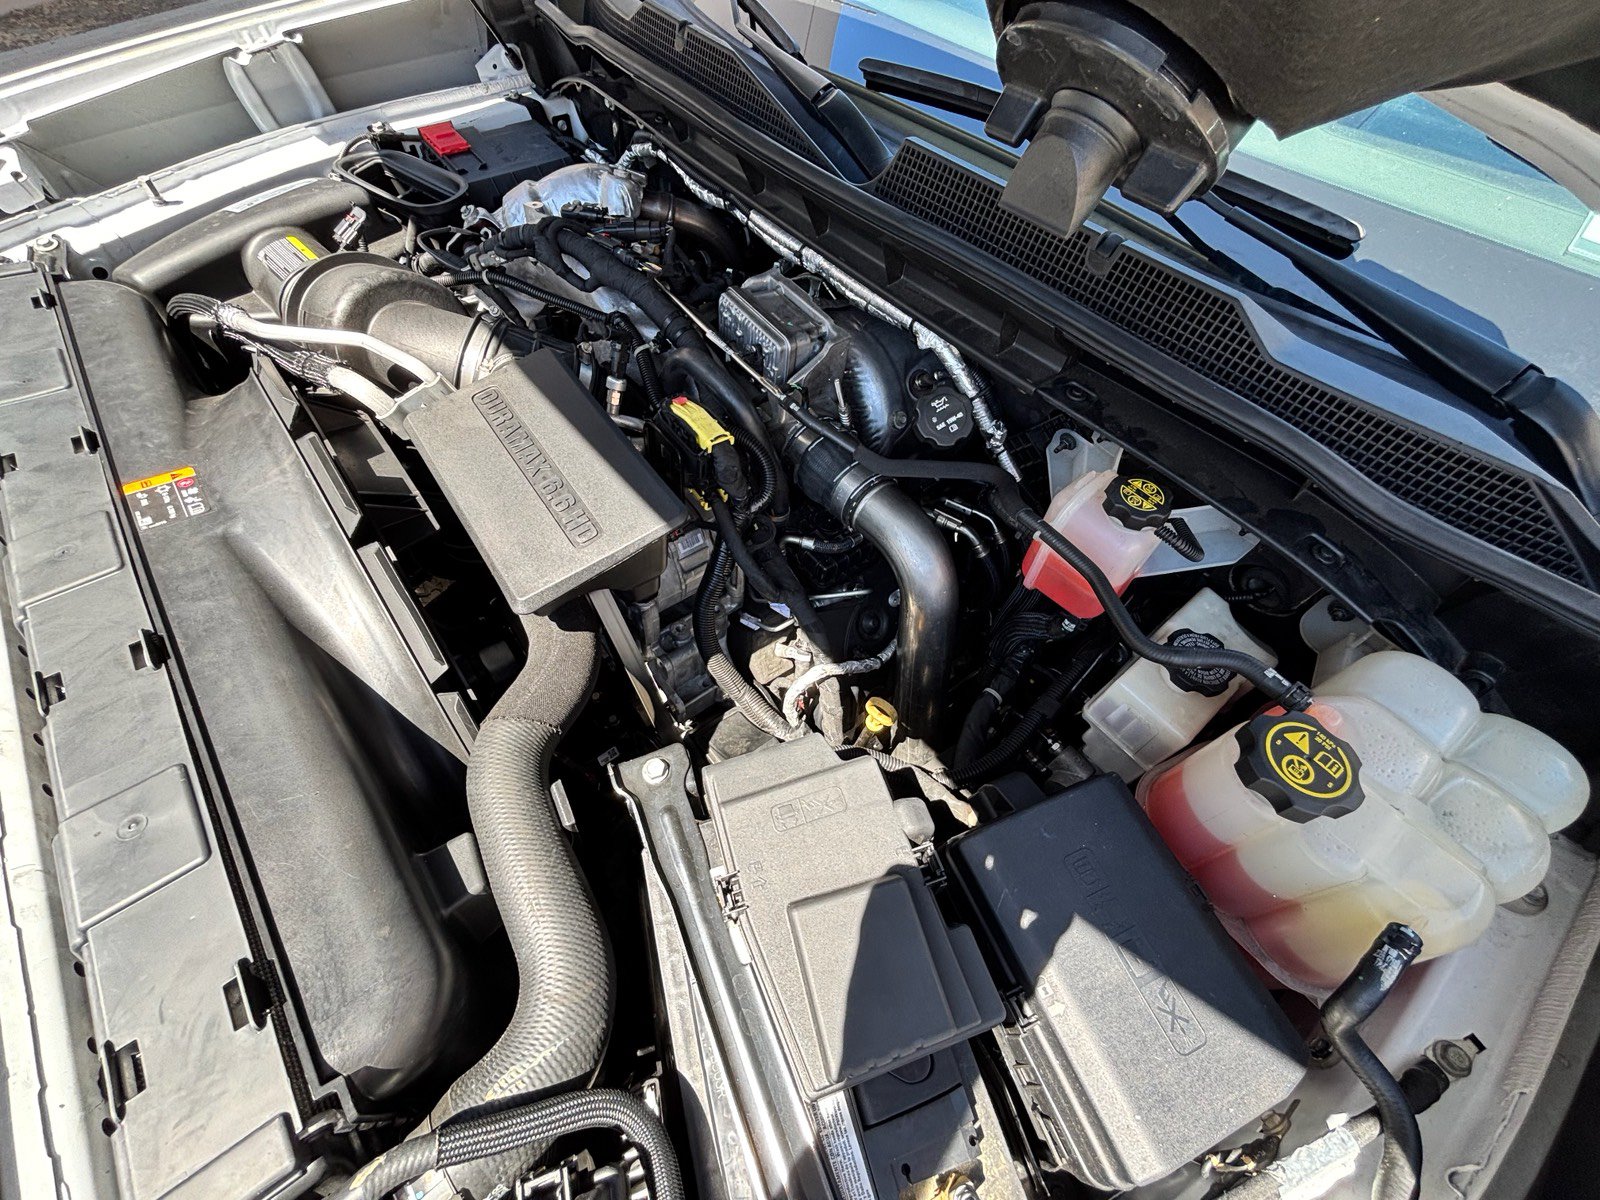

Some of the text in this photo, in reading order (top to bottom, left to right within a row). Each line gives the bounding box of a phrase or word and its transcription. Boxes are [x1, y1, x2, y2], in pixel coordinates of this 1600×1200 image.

[477, 387, 600, 546] DURAMAX 6.6 HD
